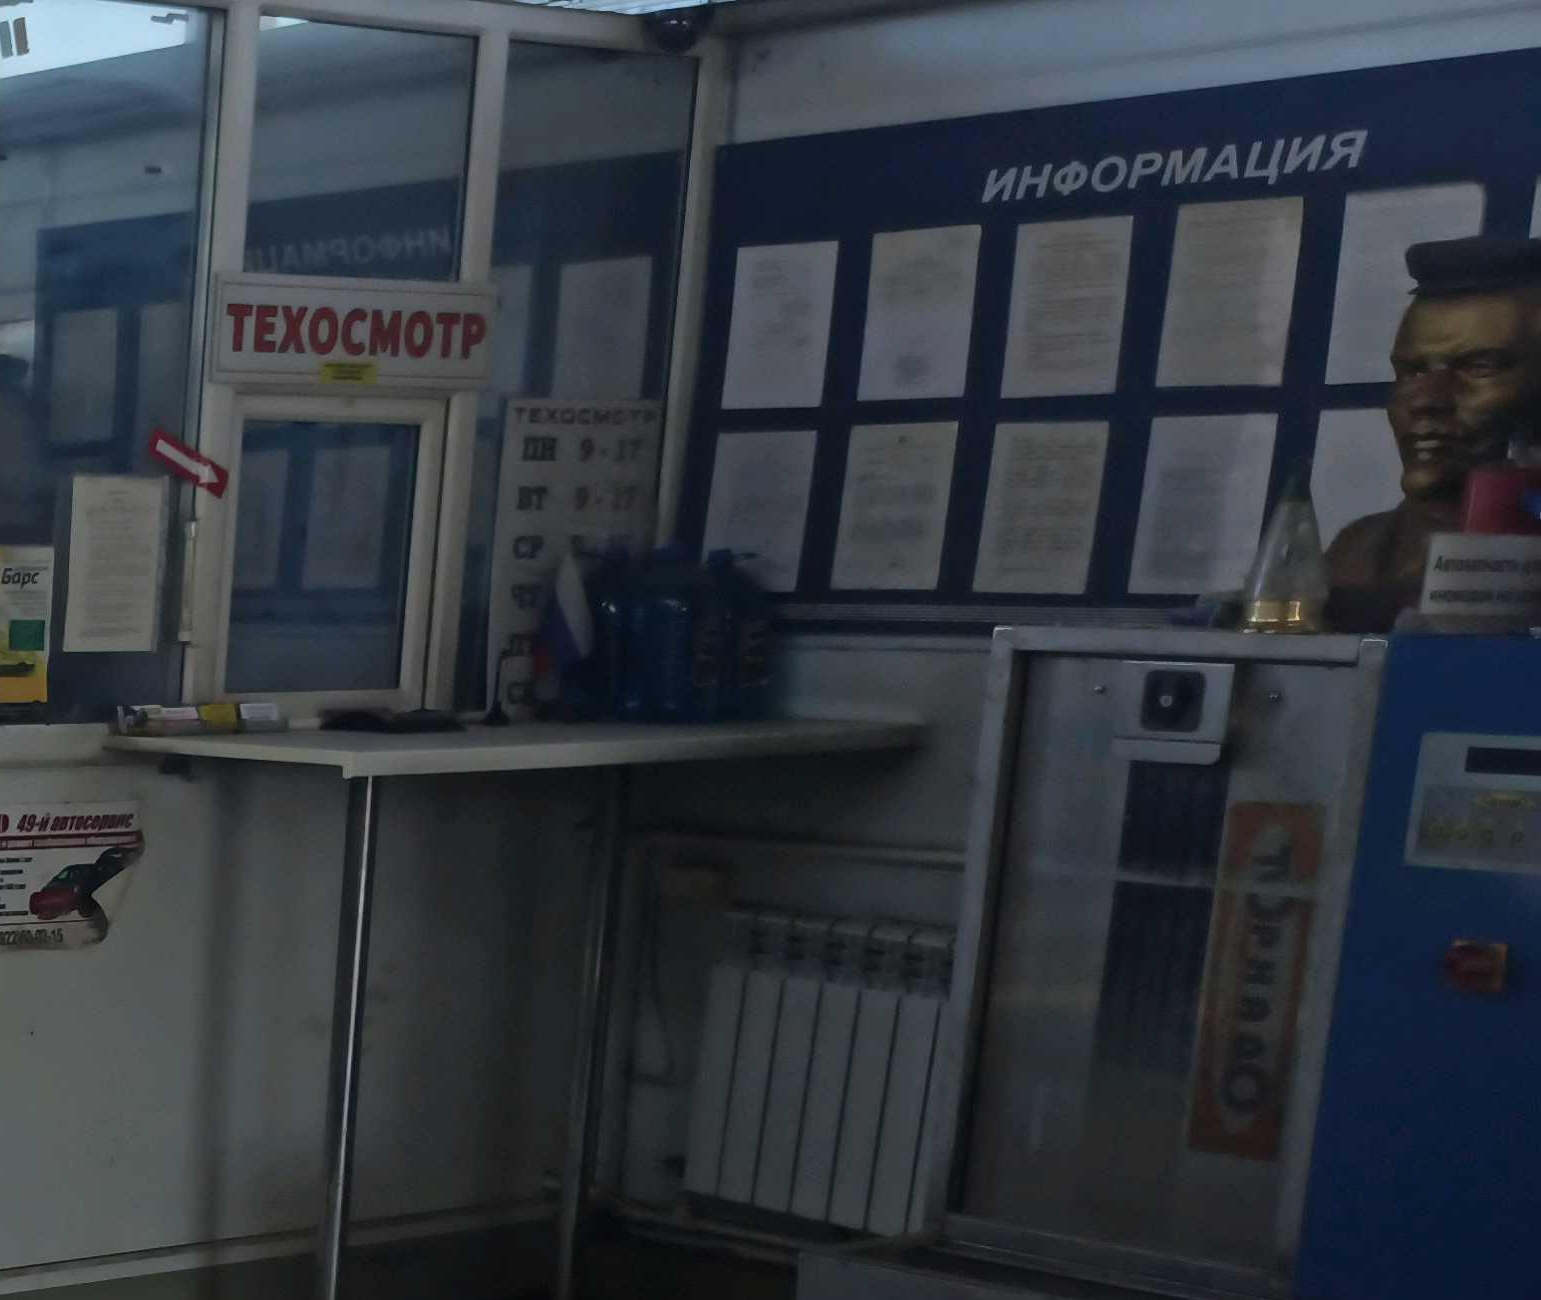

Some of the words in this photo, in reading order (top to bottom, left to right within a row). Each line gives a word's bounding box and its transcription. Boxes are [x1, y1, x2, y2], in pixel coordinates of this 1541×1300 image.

[980, 129, 1369, 203] ИНФОРМАЦИЯ
[227, 303, 486, 360] ТЕХОСМОТР
[1, 567, 40, 589] Барс
[49, 813, 134, 832] автосервис
